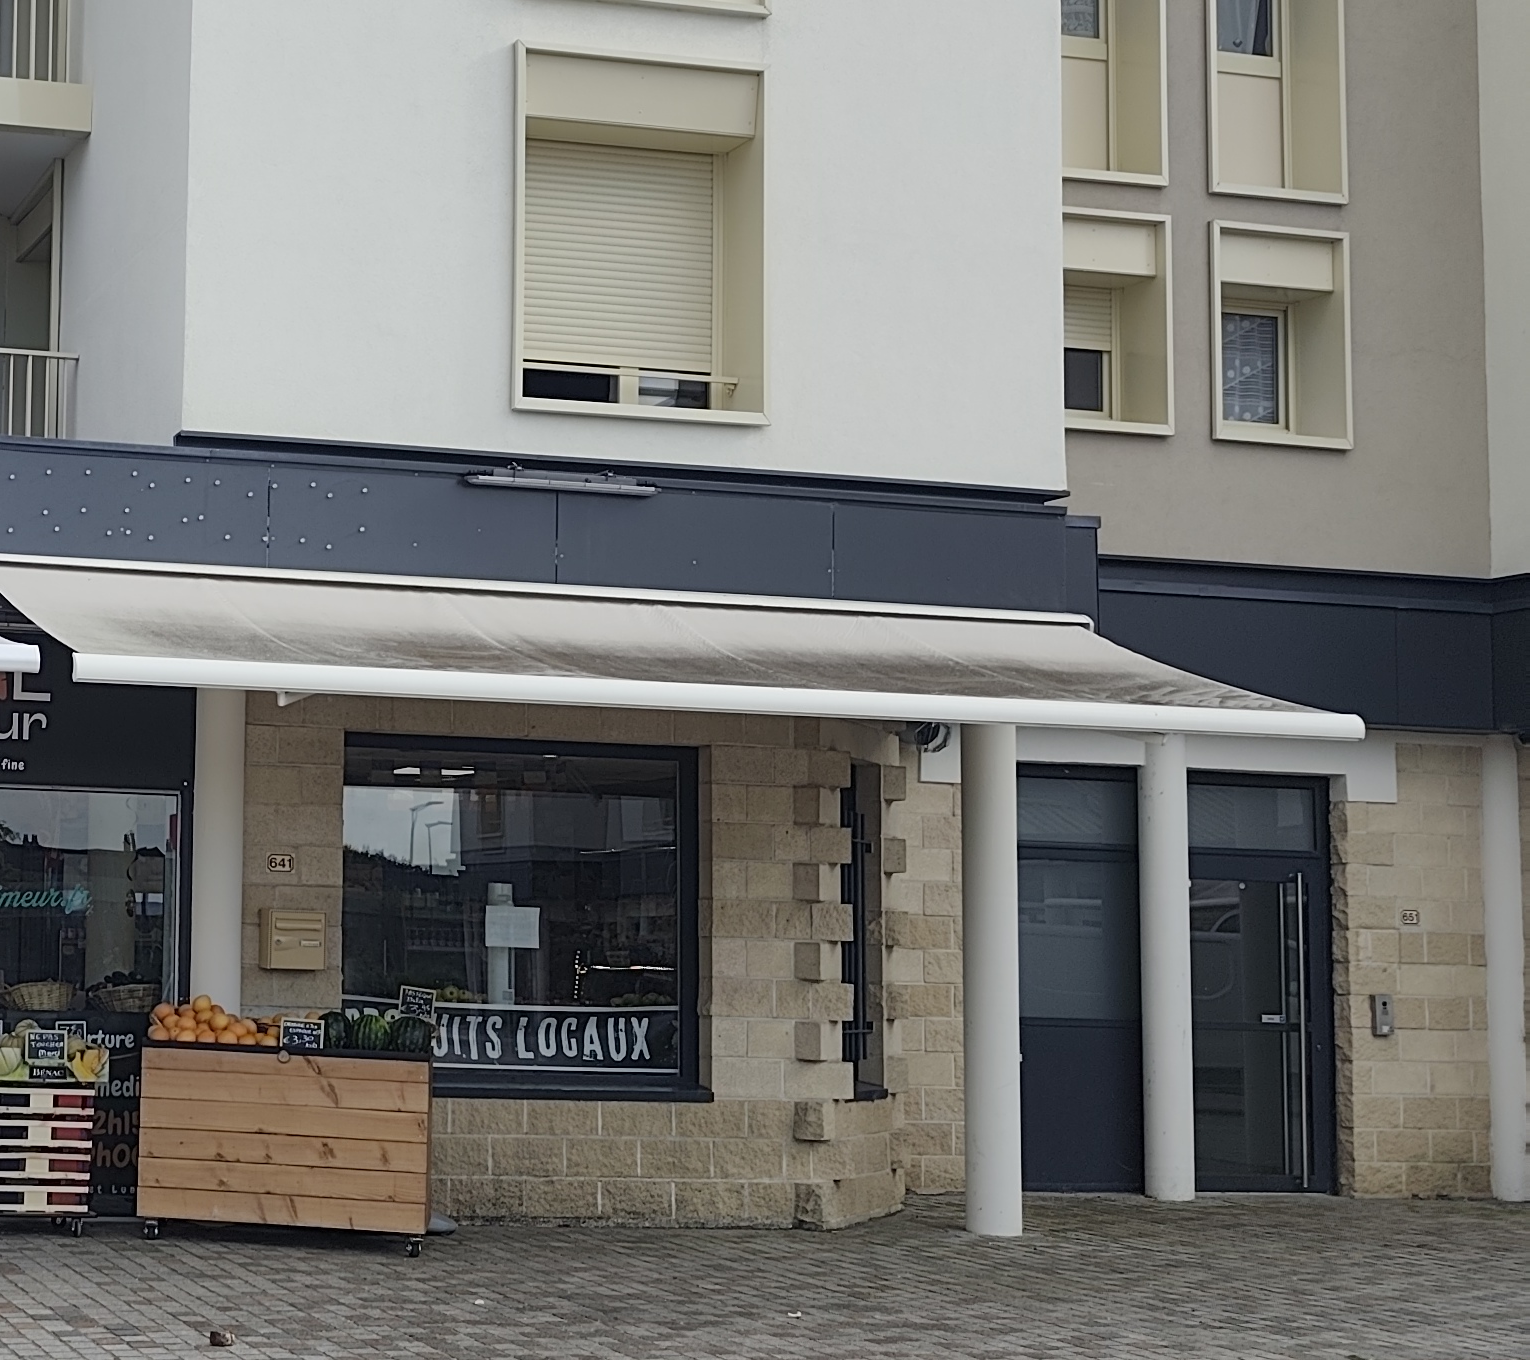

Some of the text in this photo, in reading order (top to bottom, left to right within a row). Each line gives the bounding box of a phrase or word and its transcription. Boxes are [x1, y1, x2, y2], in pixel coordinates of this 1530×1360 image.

[1, 758, 25, 771] fine
[269, 857, 292, 869] 641
[515, 1015, 651, 1063] LOCAUX
